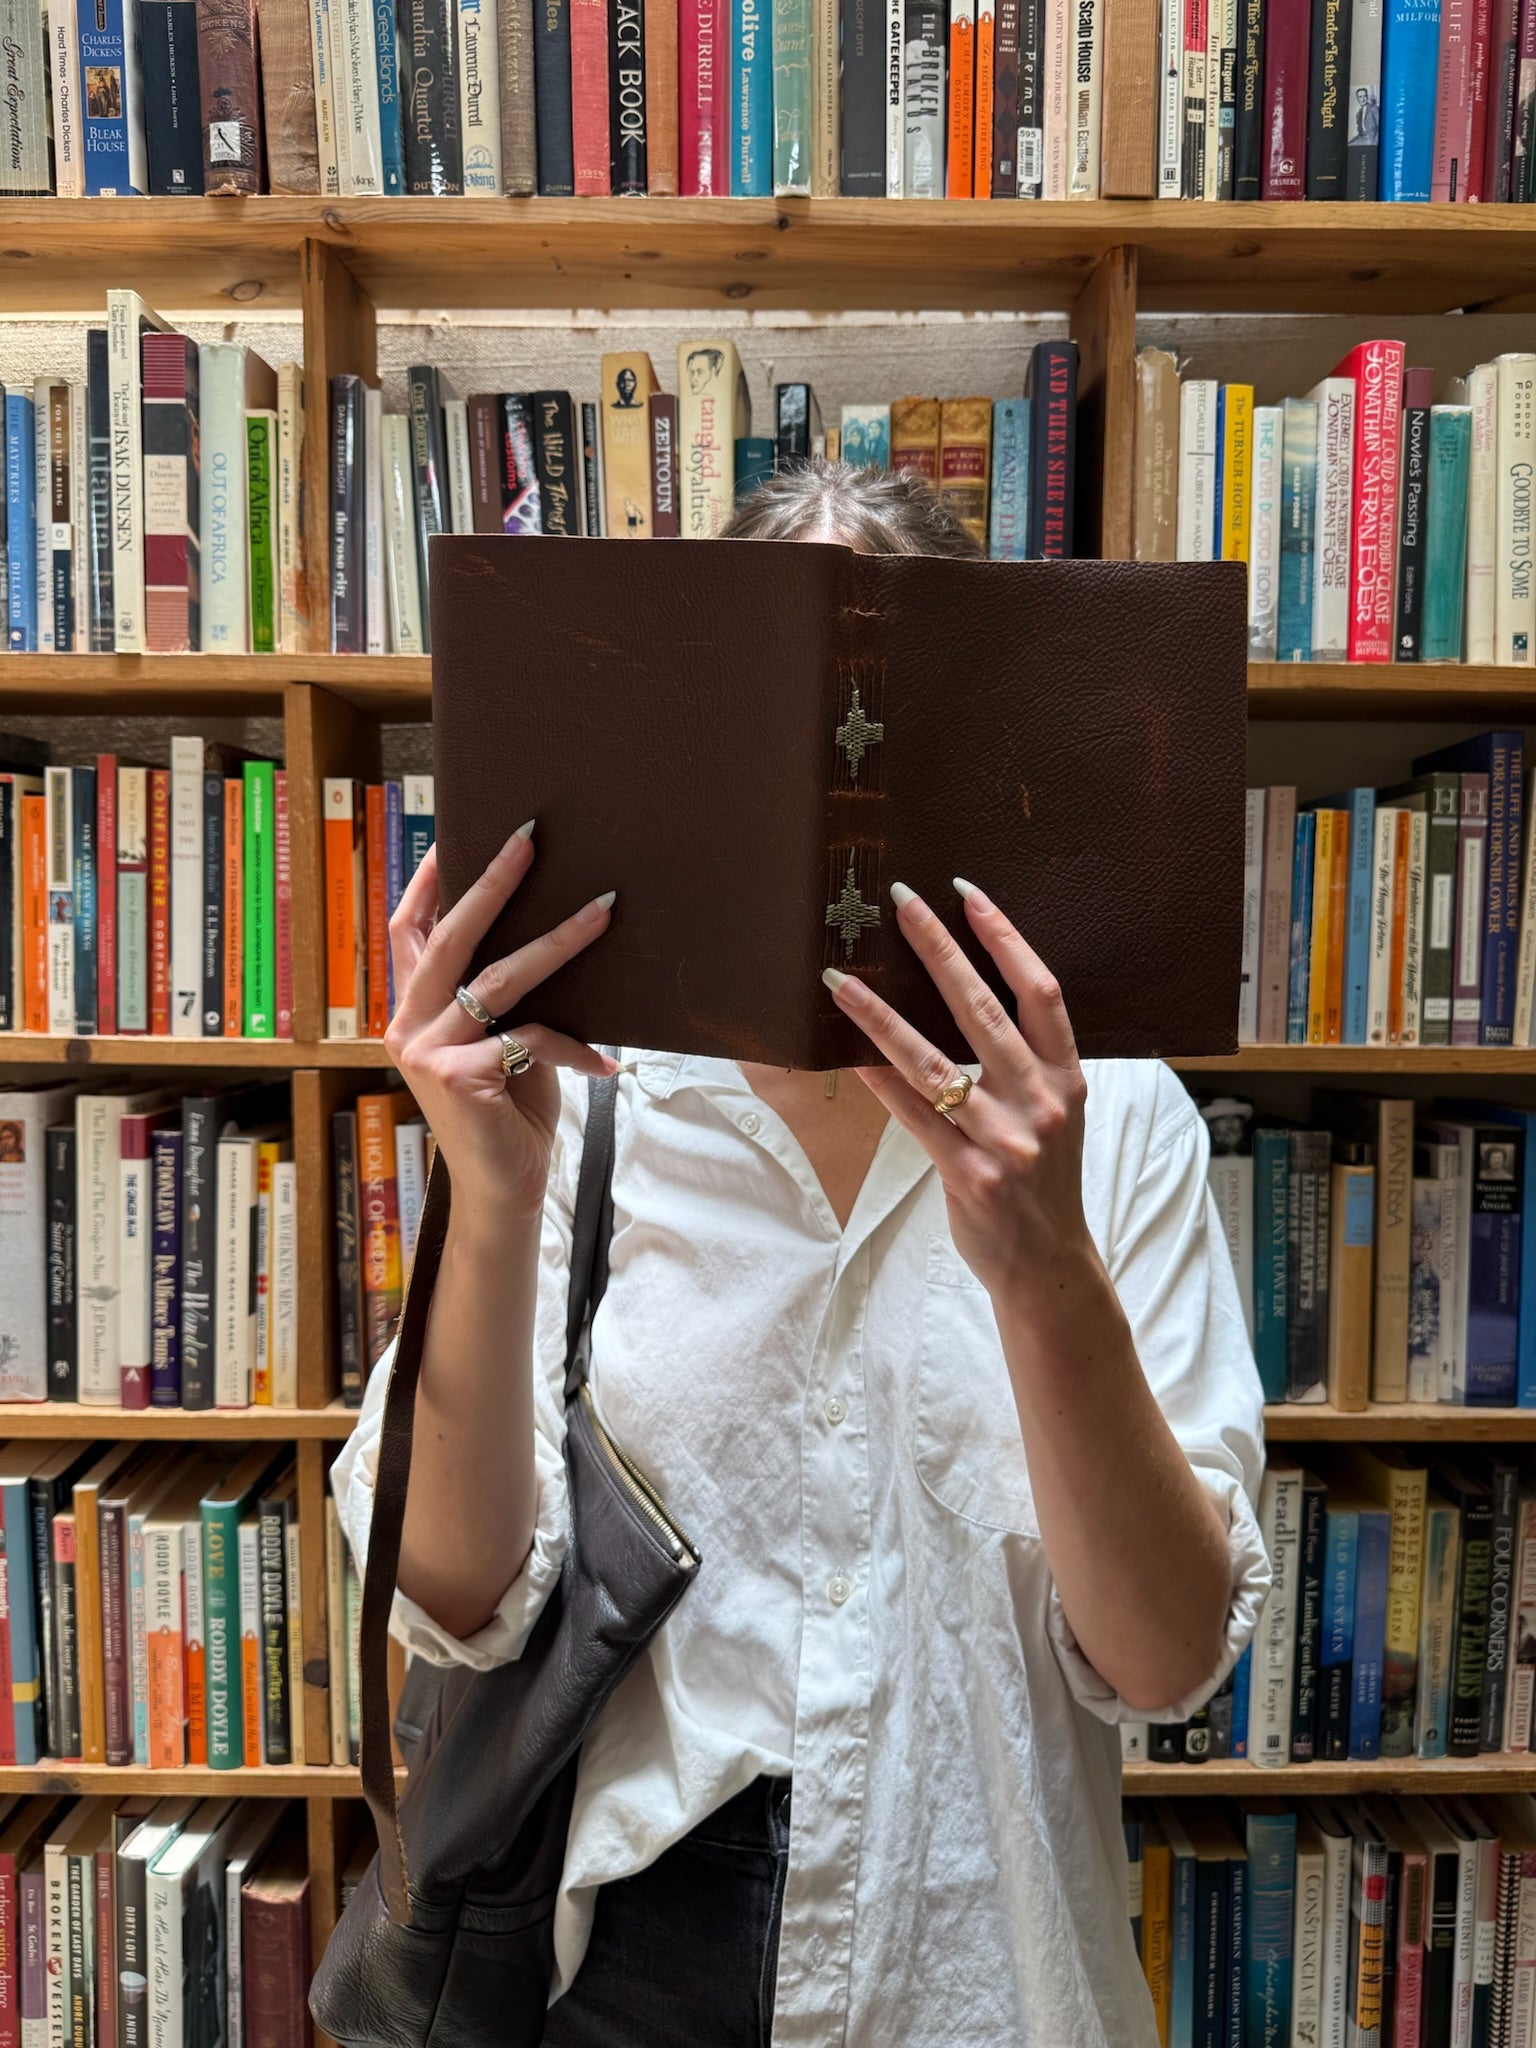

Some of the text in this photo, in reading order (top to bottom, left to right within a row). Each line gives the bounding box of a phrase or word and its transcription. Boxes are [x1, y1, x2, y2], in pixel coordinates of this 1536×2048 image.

[82, 33, 121, 44] CHARLES
[83, 46, 122, 57] DICKENS
[315, 10, 324, 50] LAWRENCE
[376, 5, 395, 104] Greek Islands
[697, 13, 713, 108] DURRELL
[890, 21, 900, 105] GATEKEEPER
[1244, 0, 1260, 111] The Last Tycoon
[1322, 0, 1340, 128] Tender Is the Night
[1449, 2, 1461, 42] LIFE
[2, 37, 24, 170] Great Expectations
[57, 26, 72, 162] Hard Times Charles Dickens
[410, 67, 433, 143] Quartet
[907, 64, 921, 134] LANDS
[921, 14, 940, 117] THE BROKEN
[1077, 1, 1094, 172] Scalp House William Eastlake
[1223, 53, 1234, 102] Fitzgerald
[87, 139, 125, 152] HOUSE
[88, 127, 122, 139] BLEAK
[620, 69, 644, 148] BOOK
[741, 68, 752, 183] Lawrence Durrell
[544, 400, 559, 427] The
[1050, 354, 1067, 393] AND
[1382, 348, 1399, 435] EXTREMELY
[655, 417, 671, 513] ZEITOUN
[696, 398, 721, 478] tangled
[1048, 399, 1067, 454] THEN
[1232, 397, 1245, 530] The TURNER HOUSE
[1381, 438, 1395, 480] LOUD
[115, 430, 132, 551] ISAK DINESEN
[212, 453, 228, 583] OUT OF AFRICA
[248, 425, 267, 544] Out of Africa
[686, 444, 710, 531] loyalties
[1047, 460, 1066, 501] SHE
[1356, 350, 1383, 624] JONATHAN SAFRAN FOER
[1403, 482, 1421, 546] Passing
[11, 436, 21, 617] MAYTREES DILLARD
[334, 512, 347, 598] the rose city
[1378, 497, 1394, 573] INCREDIBLY
[1510, 463, 1532, 599] GOODBYE TO SOME
[1375, 576, 1390, 624] CLOSE
[1489, 748, 1505, 933] HORATIO HORNBLOWER
[1506, 749, 1520, 932] THE LIFE AND TIMES OF
[365, 1105, 381, 1132] THE
[367, 1137, 383, 1194] HOUSE
[1272, 1156, 1286, 1184] The
[1387, 1117, 1407, 1228] MANTISSA
[368, 1200, 384, 1223] OF
[156, 1255, 175, 1272] De
[1272, 1255, 1285, 1317] TOWER
[154, 1327, 175, 1369] Tennis
[184, 1259, 209, 1367] The Wonder
[188, 1538, 198, 1579] RODDY
[261, 1516, 282, 1623] RODDY DOYLE
[1488, 1527, 1512, 1671] FOUR CORNERS
[189, 1586, 199, 1627] DOYLE
[208, 1521, 228, 1755] LOVE RODDY DOYLE
[1264, 1481, 1297, 1722] headlong Michael Frayn
[1332, 1570, 1347, 1653] MOUNTAIN
[1458, 1540, 1489, 1698] GREAT PLAINS
[51, 1880, 61, 1952] BROKEN
[71, 1865, 82, 1978] THE GARDEN OF LAST DAYS
[154, 1892, 168, 1911] The
[154, 1914, 168, 1955] Heart
[1460, 1860, 1475, 1960] CARLOS FUENTES
[125, 1906, 136, 2045] DIRTY LOVE ANDRE
